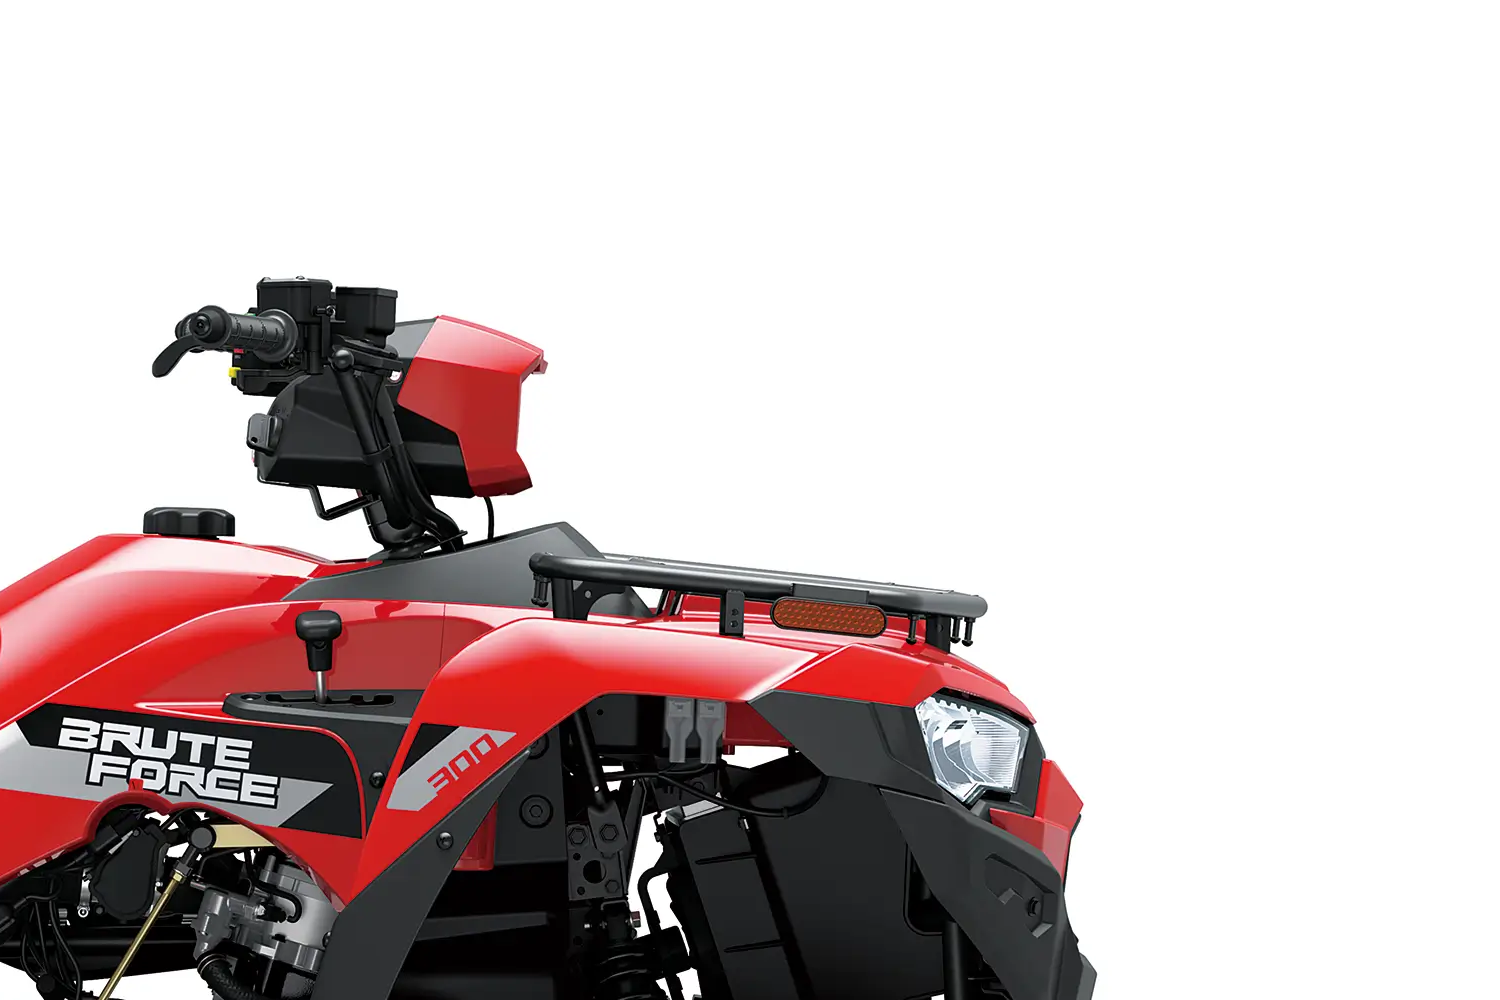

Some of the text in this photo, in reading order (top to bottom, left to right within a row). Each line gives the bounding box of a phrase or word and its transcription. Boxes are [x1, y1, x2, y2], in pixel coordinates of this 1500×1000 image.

[58, 717, 253, 770] BRUTE
[426, 733, 498, 796] 300
[87, 753, 280, 808] FORCE
